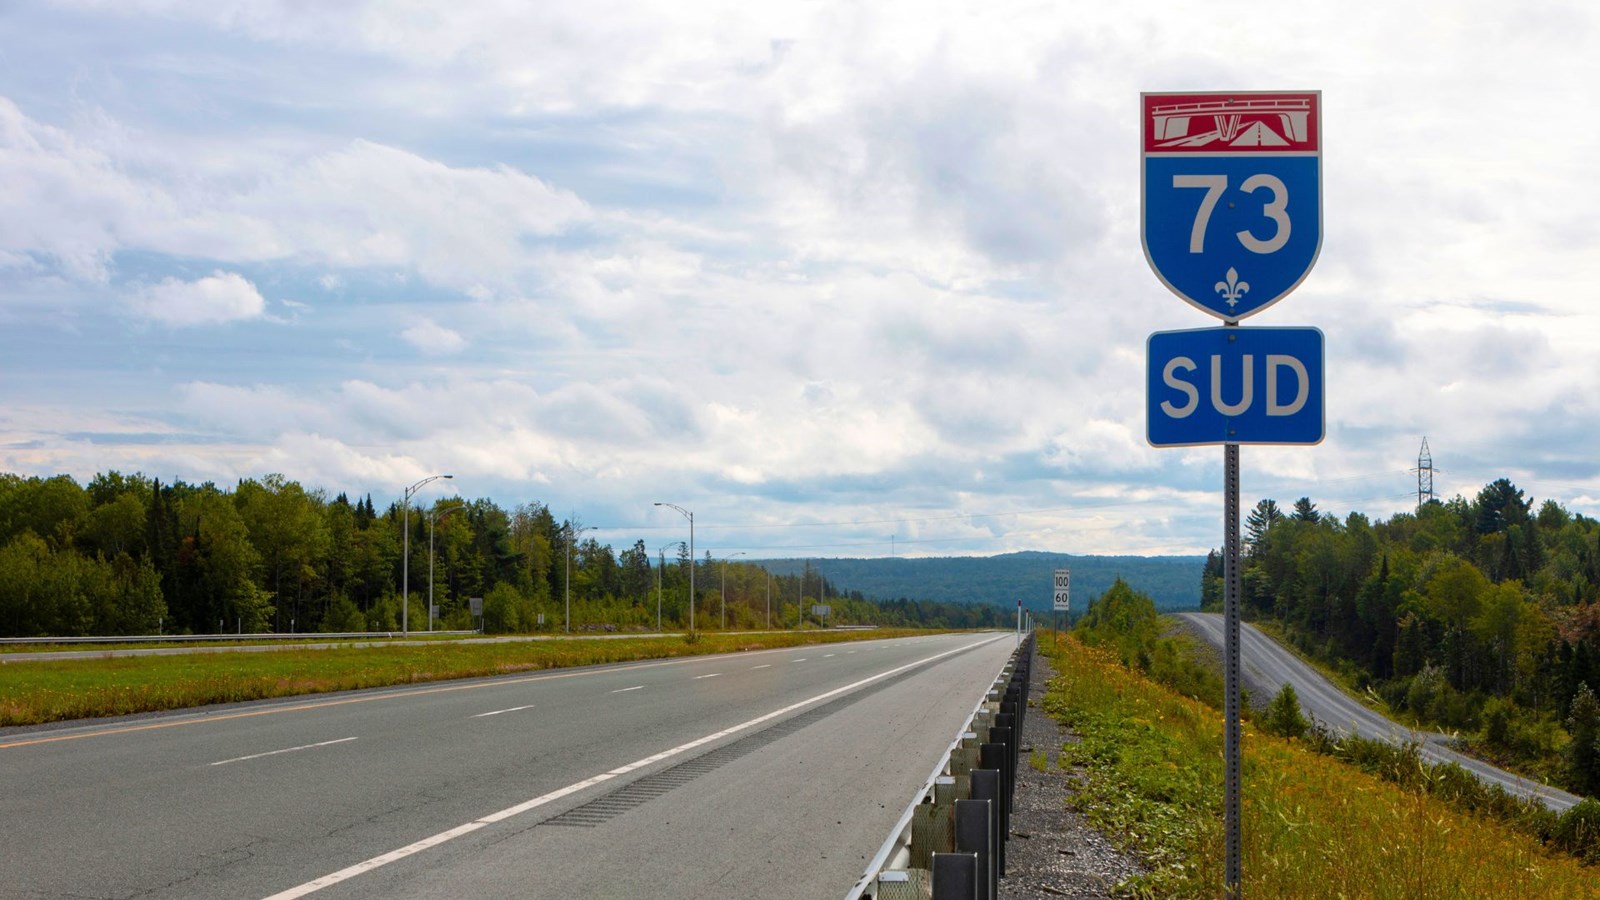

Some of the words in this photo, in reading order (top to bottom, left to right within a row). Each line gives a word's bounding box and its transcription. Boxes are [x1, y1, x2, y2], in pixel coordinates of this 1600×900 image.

[1172, 173, 1292, 255] 73
[1159, 354, 1310, 419] SUD
[1055, 576, 1069, 587] 100
[1055, 593, 1068, 603] 60
